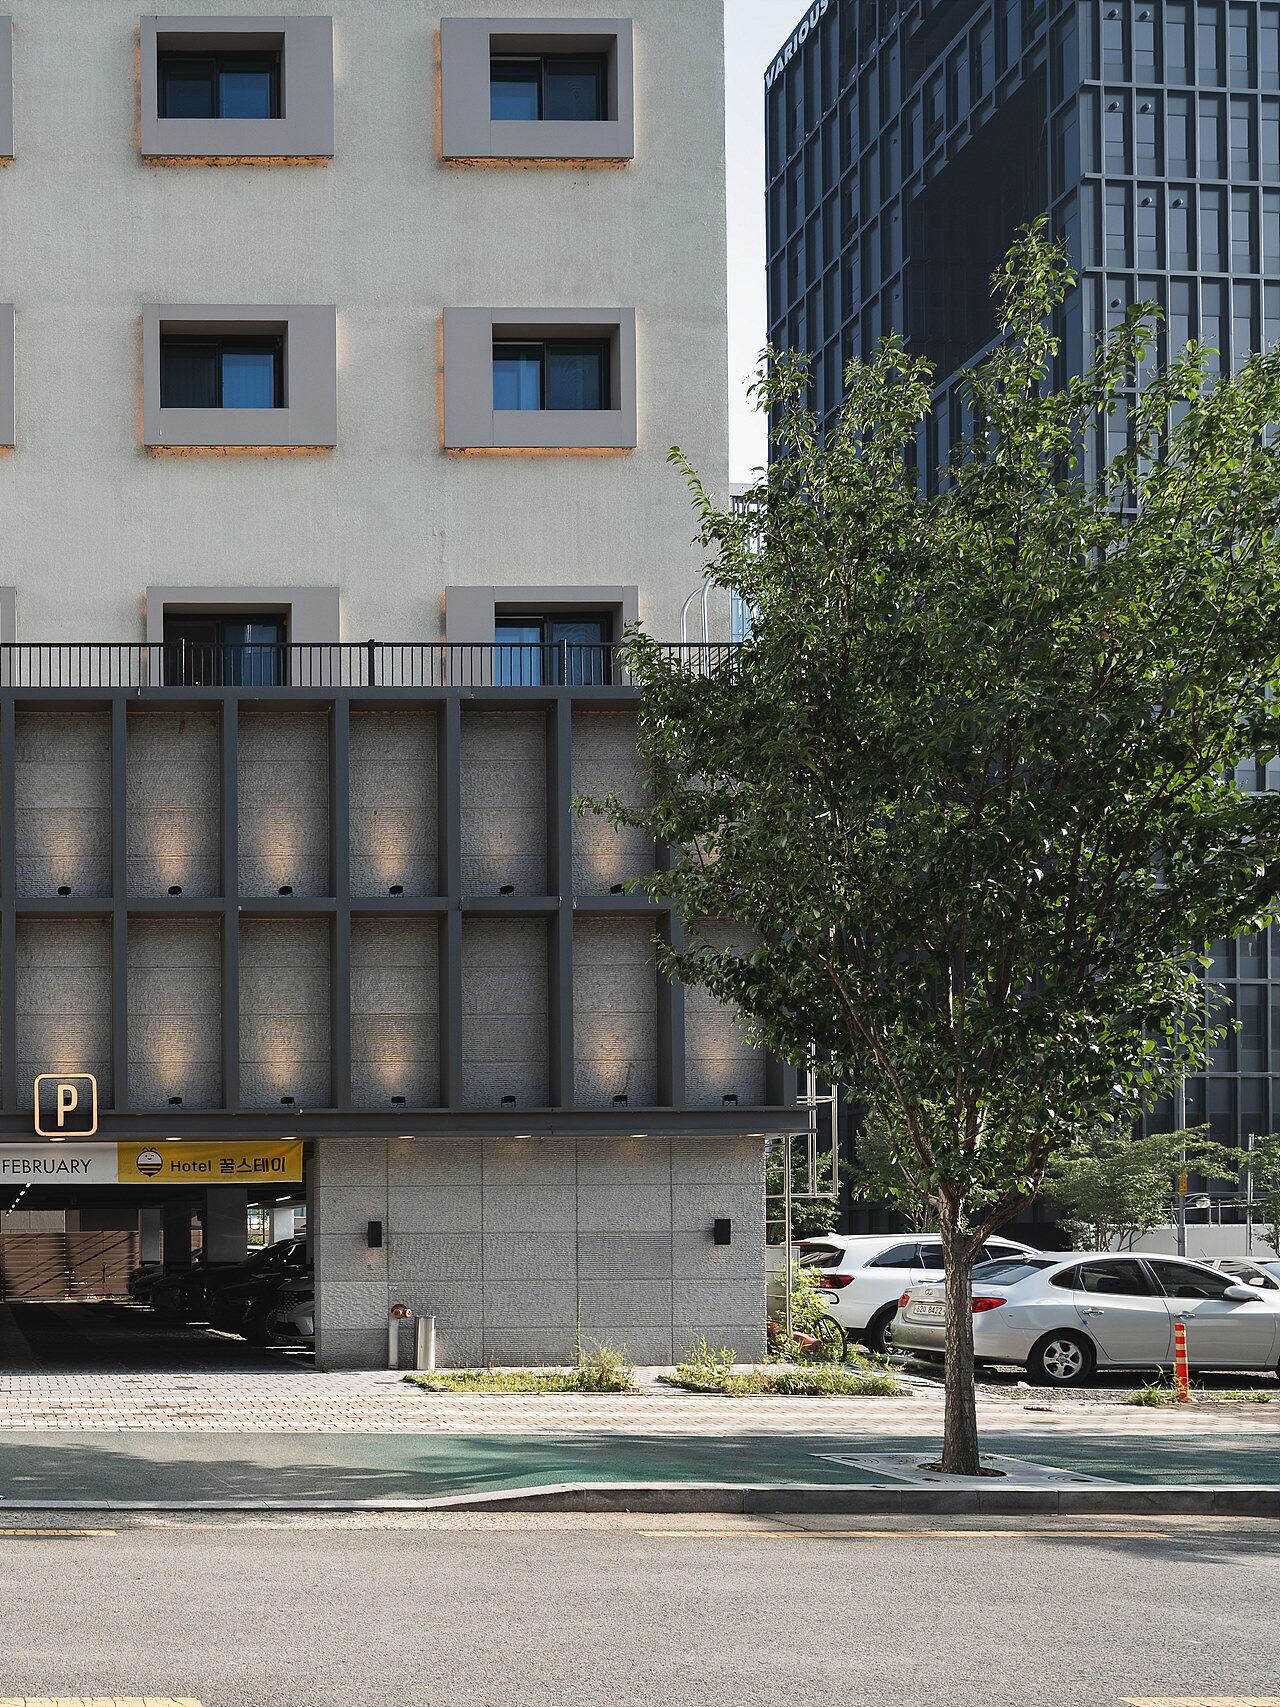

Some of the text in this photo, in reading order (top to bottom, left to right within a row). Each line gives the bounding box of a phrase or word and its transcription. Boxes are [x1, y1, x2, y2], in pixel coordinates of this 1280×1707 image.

[765, 0, 829, 90] VARIOUS
[57, 1084, 79, 1128] P
[2, 1158, 92, 1175] FEBRUARY
[170, 1157, 286, 1174] Hotel 꿀스테이
